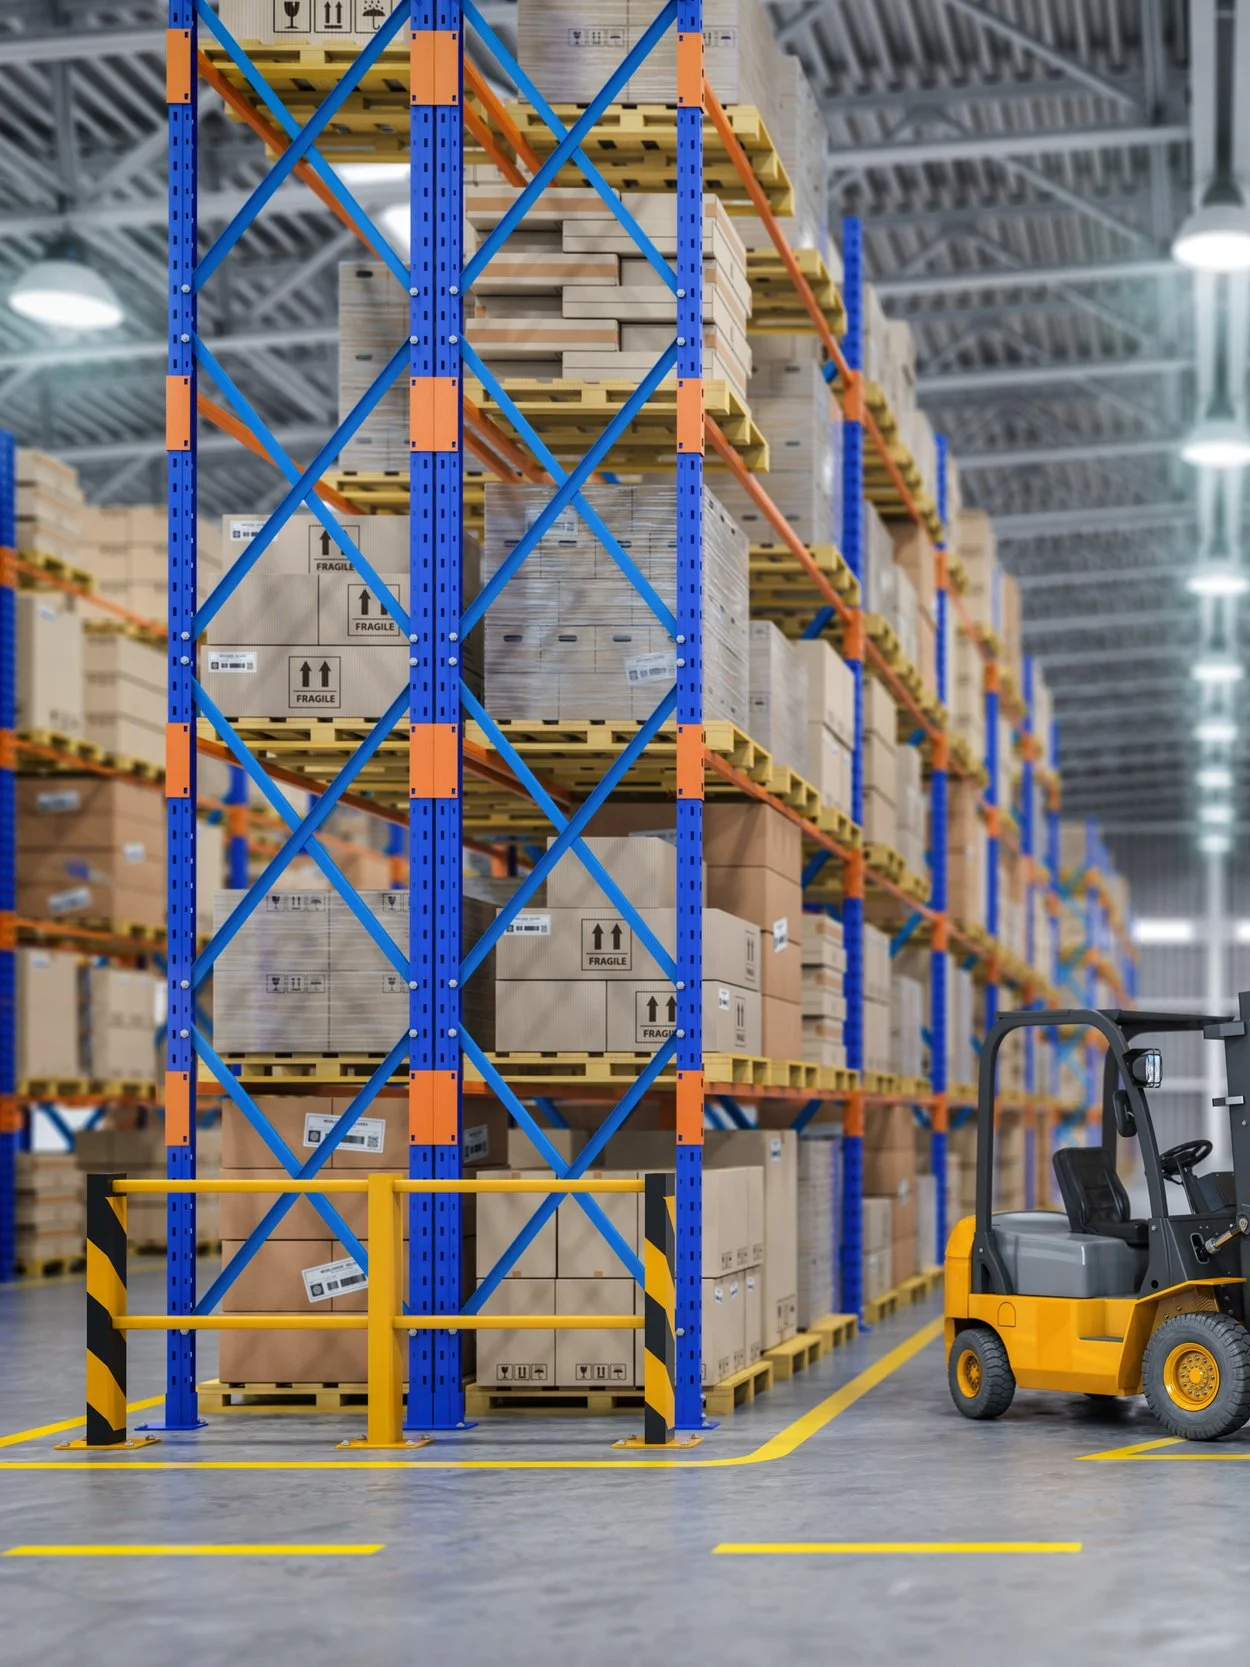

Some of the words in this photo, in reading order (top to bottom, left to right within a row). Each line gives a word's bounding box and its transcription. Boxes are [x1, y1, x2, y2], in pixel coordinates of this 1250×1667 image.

[355, 622, 394, 631] FRAGILE
[296, 694, 336, 703] FRAGILE
[588, 957, 627, 966] FRAGILE
